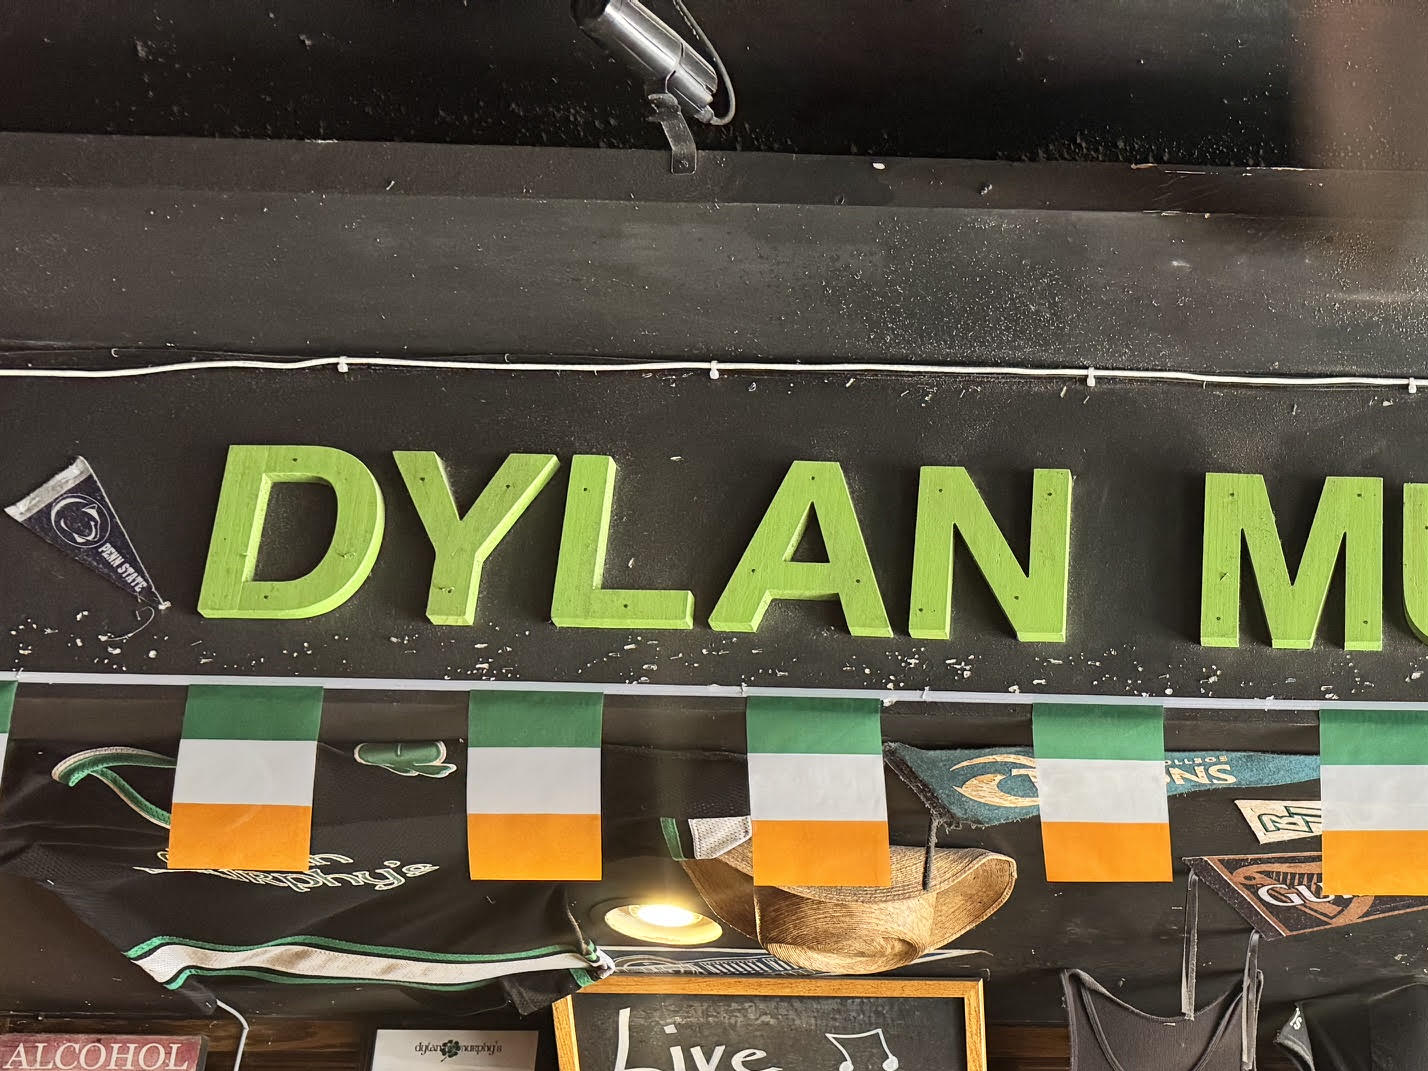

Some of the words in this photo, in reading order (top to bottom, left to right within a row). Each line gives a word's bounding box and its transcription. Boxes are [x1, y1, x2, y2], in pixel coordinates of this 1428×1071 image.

[98, 543, 121, 567] PENN
[117, 562, 148, 592] STATE
[197, 444, 1073, 643] DYLAN
[2, 1042, 189, 1070] ALCOHOL
